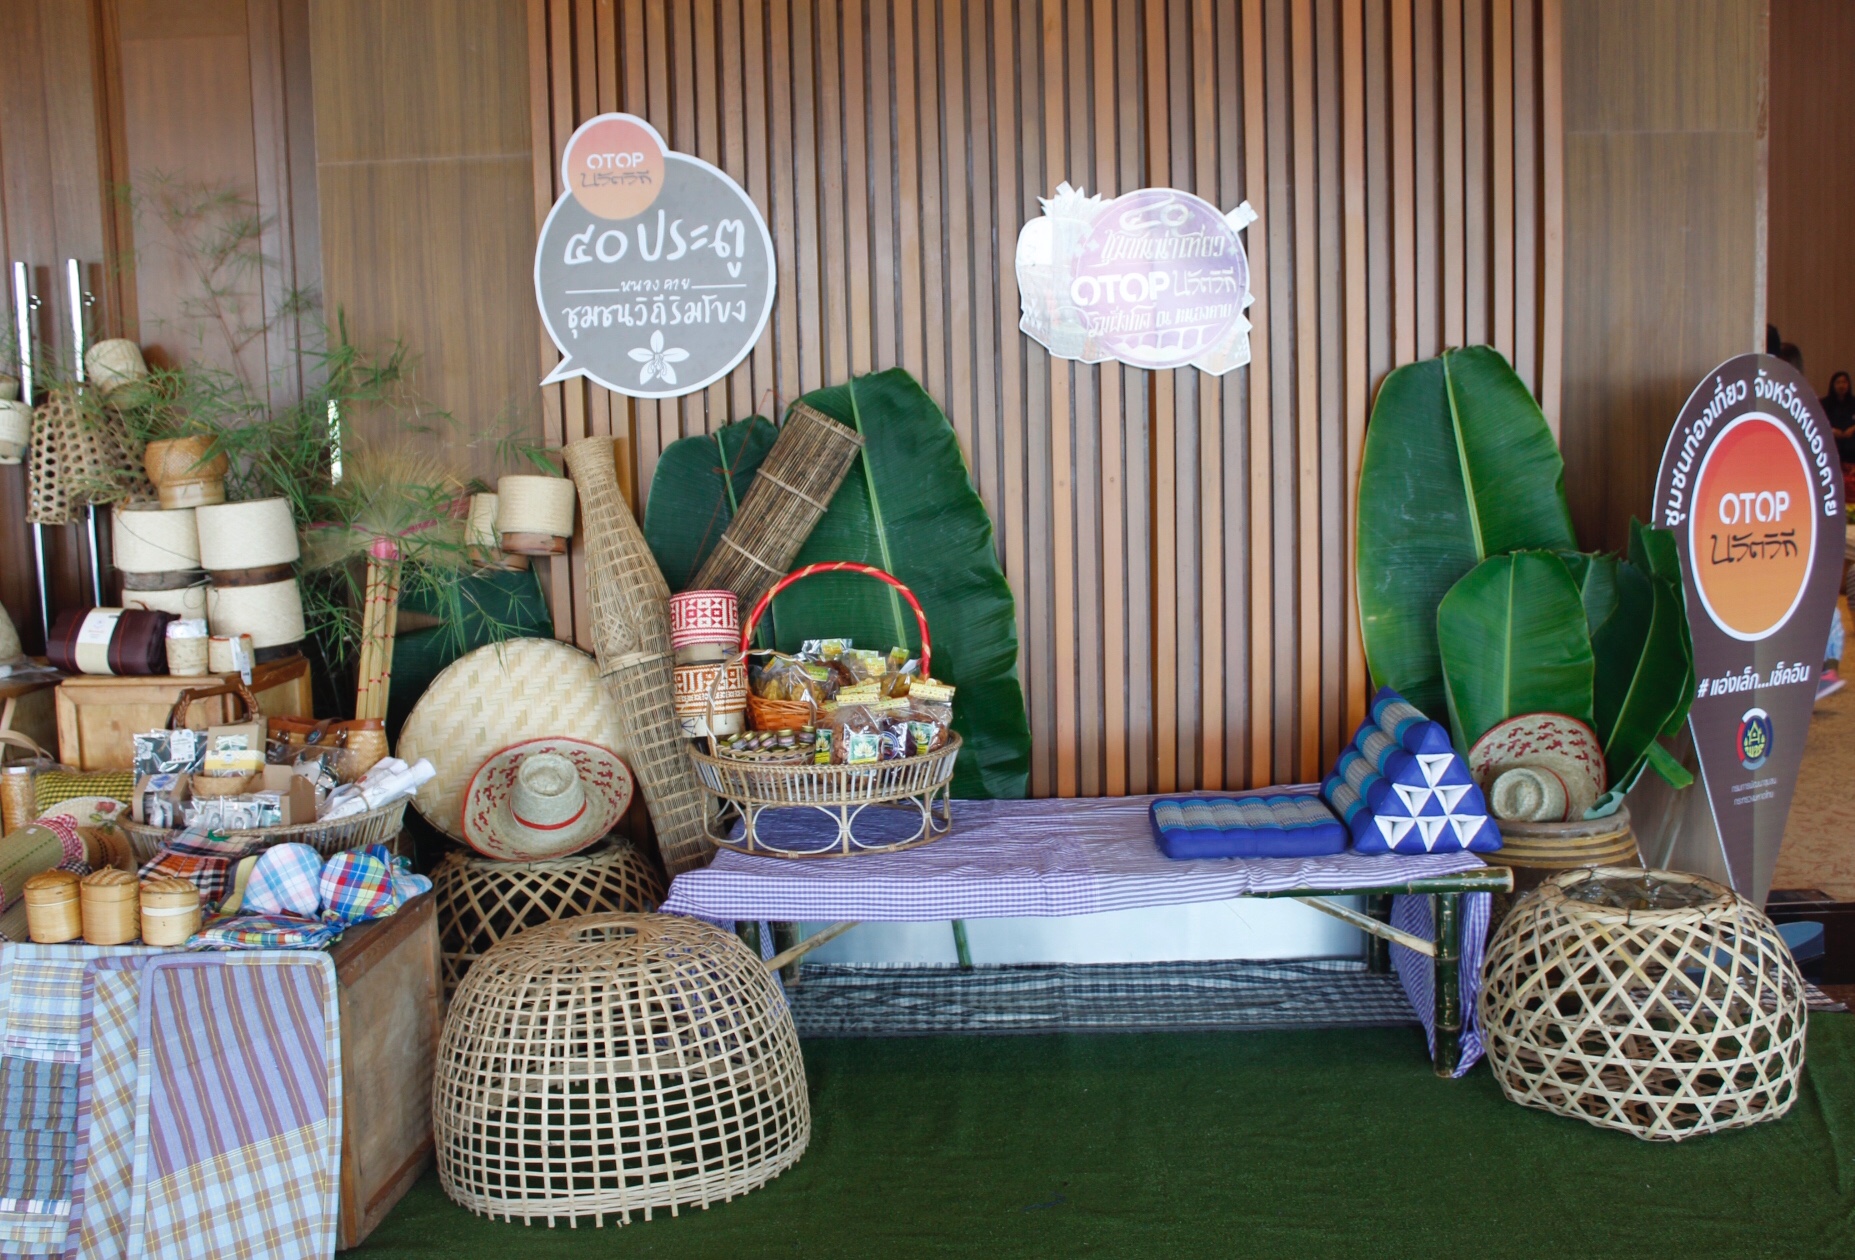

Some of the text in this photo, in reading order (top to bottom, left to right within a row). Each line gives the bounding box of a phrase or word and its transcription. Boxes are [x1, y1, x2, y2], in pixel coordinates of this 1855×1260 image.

[580, 170, 652, 188] นวัตวิถี
[586, 152, 645, 171] OTOP
[563, 209, 745, 278] ๔๐ ประตู
[620, 278, 690, 292] หนองคาย
[1070, 271, 1170, 306] OTOP
[561, 294, 746, 339] ชุมชนวิถีริมโขง
[1665, 369, 1838, 527] ชุมชนท่องเที่ยว จังหวัดหนองคาย
[1718, 490, 1790, 525] OTOP
[1711, 528, 1798, 565] นวัตวิถี
